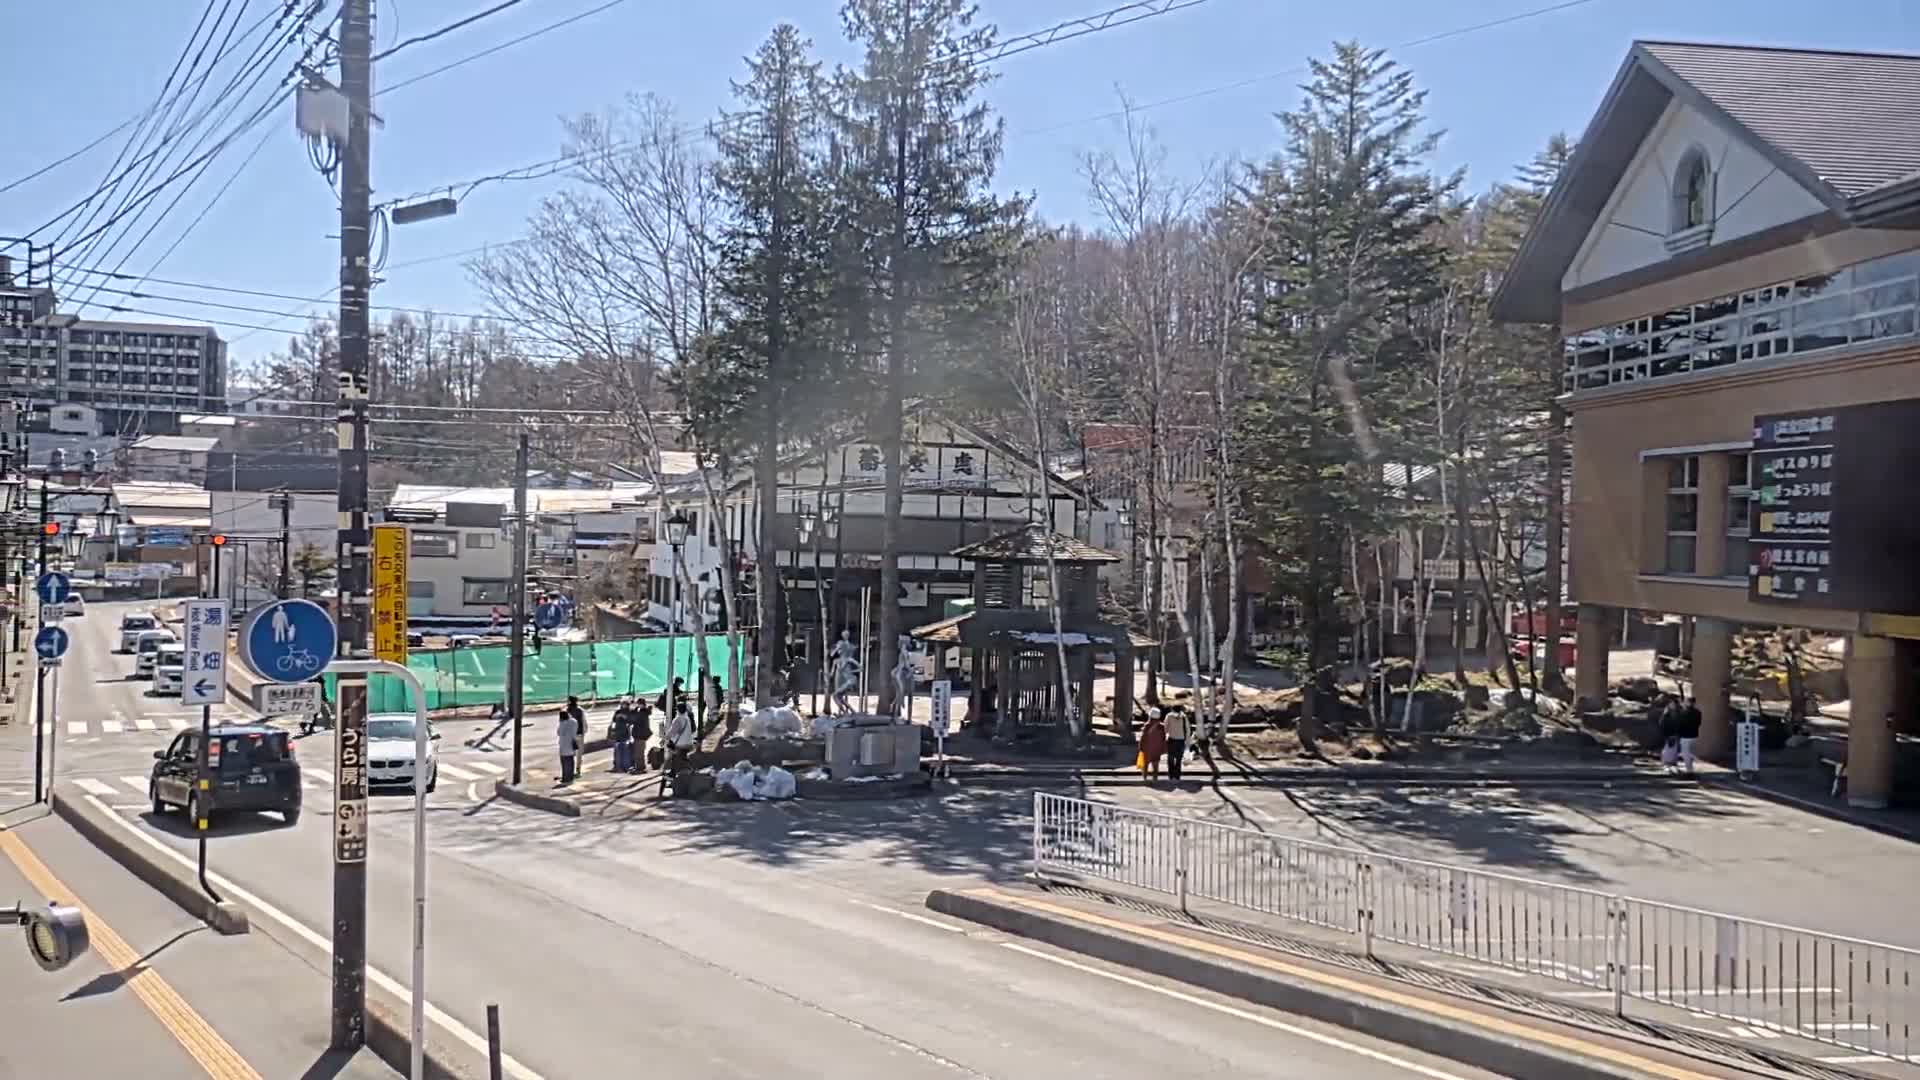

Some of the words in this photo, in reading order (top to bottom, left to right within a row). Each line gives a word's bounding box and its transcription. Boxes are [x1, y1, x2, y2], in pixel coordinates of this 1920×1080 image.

[191, 607, 200, 622] Hot
[378, 556, 393, 652] 右折禁止
[190, 624, 200, 649] Water
[203, 607, 222, 670] 湯畑
